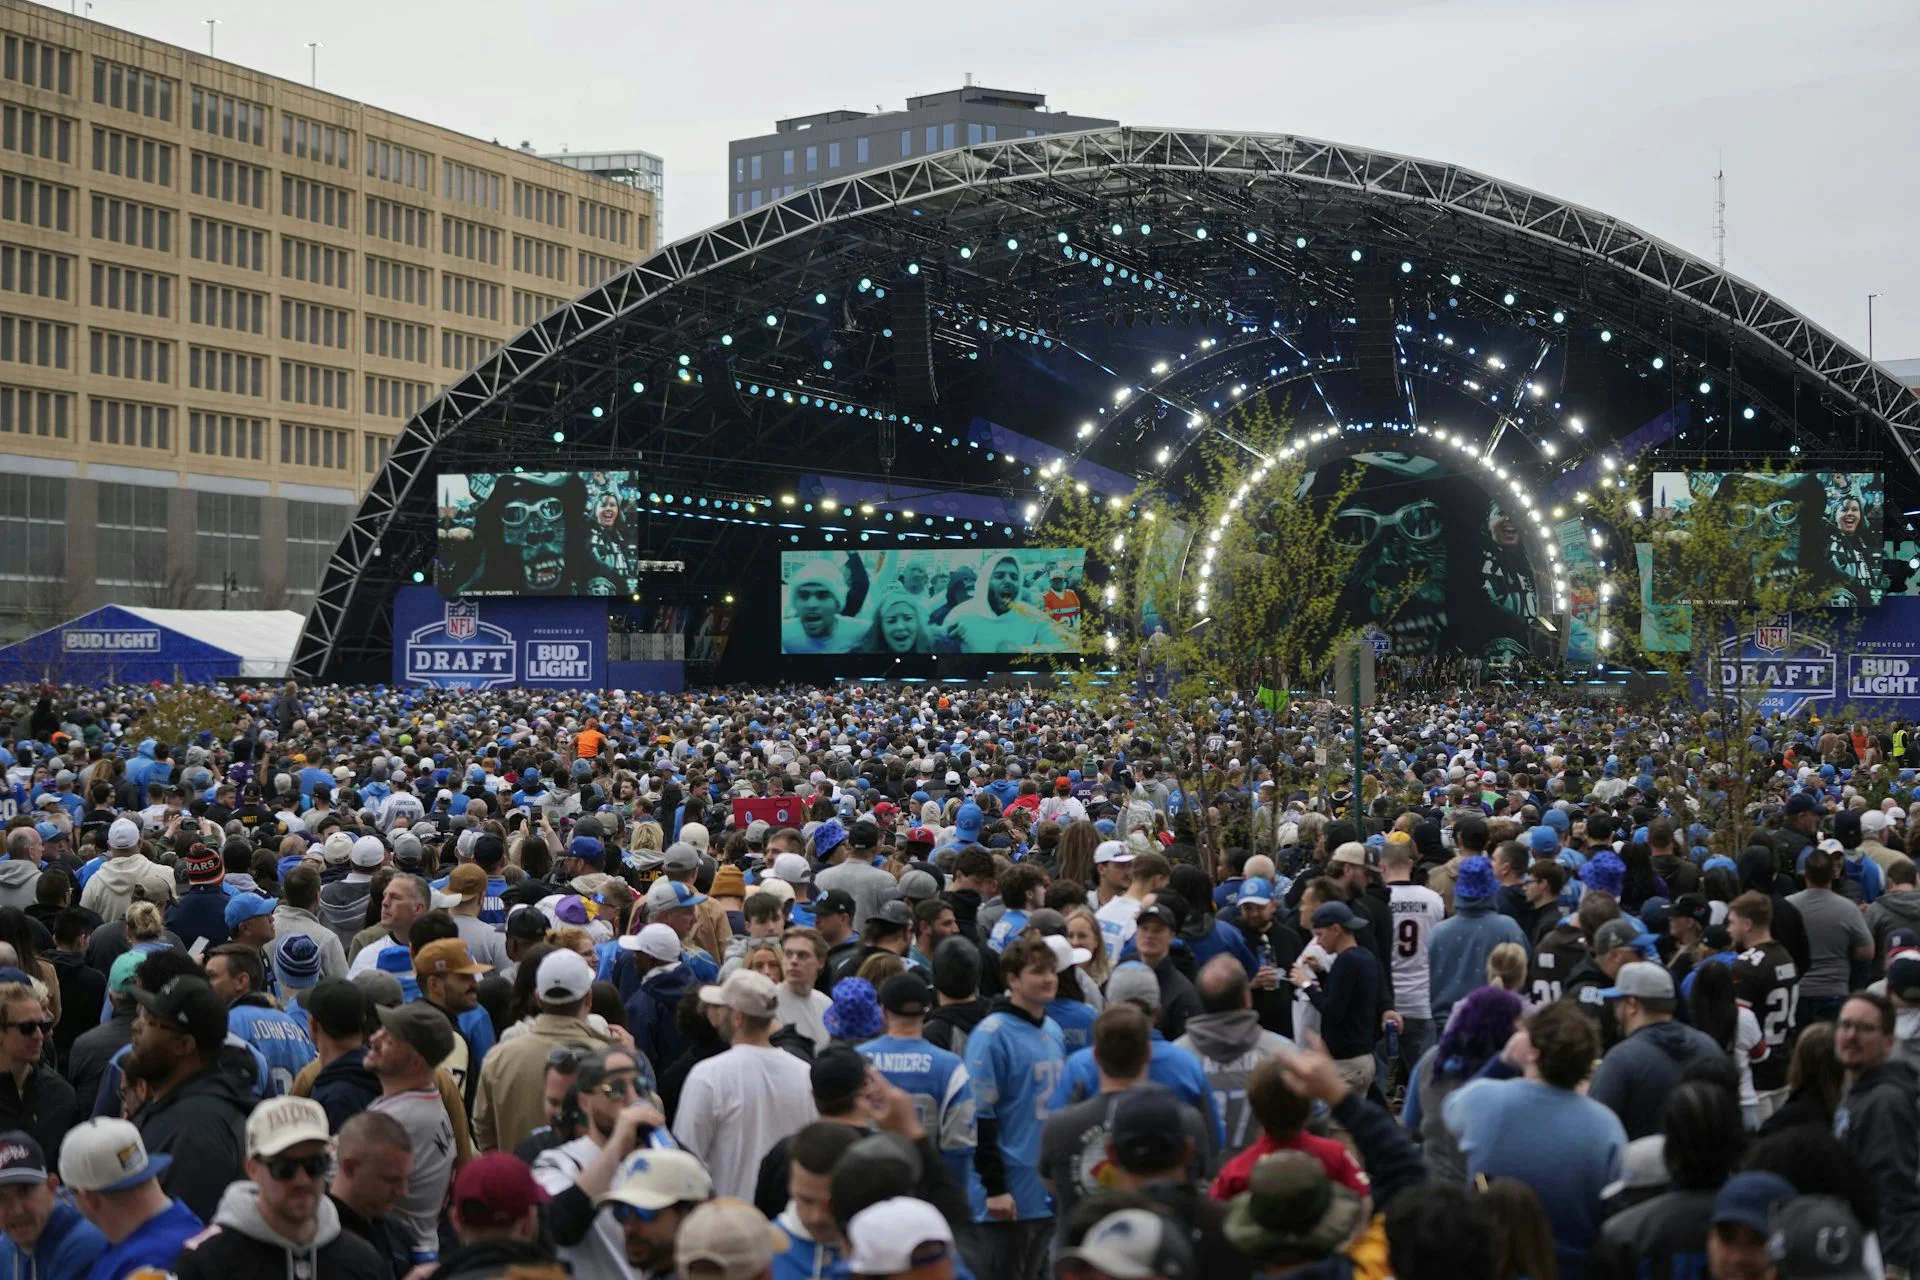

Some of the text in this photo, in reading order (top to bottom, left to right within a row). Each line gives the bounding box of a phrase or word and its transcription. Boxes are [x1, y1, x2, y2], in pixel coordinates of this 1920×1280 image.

[450, 618, 474, 635] NFL
[66, 633, 156, 649] BUD LIGHT
[1759, 628, 1787, 645] NFL
[414, 651, 507, 671] DRAFT
[537, 644, 579, 661] BUD
[529, 660, 588, 677] LIGHT
[1721, 665, 1826, 686] DRAFT
[1861, 659, 1910, 676] BUD
[449, 681, 472, 690] 2024
[1852, 676, 1919, 694] LIGHT
[1758, 697, 1785, 706] 2024
[0, 798, 17, 820] 0
[242, 815, 258, 823] WATT
[187, 860, 214, 872] EARS
[1391, 901, 1428, 913] BURROW
[1398, 919, 1418, 958] 9
[1034, 1060, 1065, 1121] 2
[1213, 1088, 1252, 1148] 7
